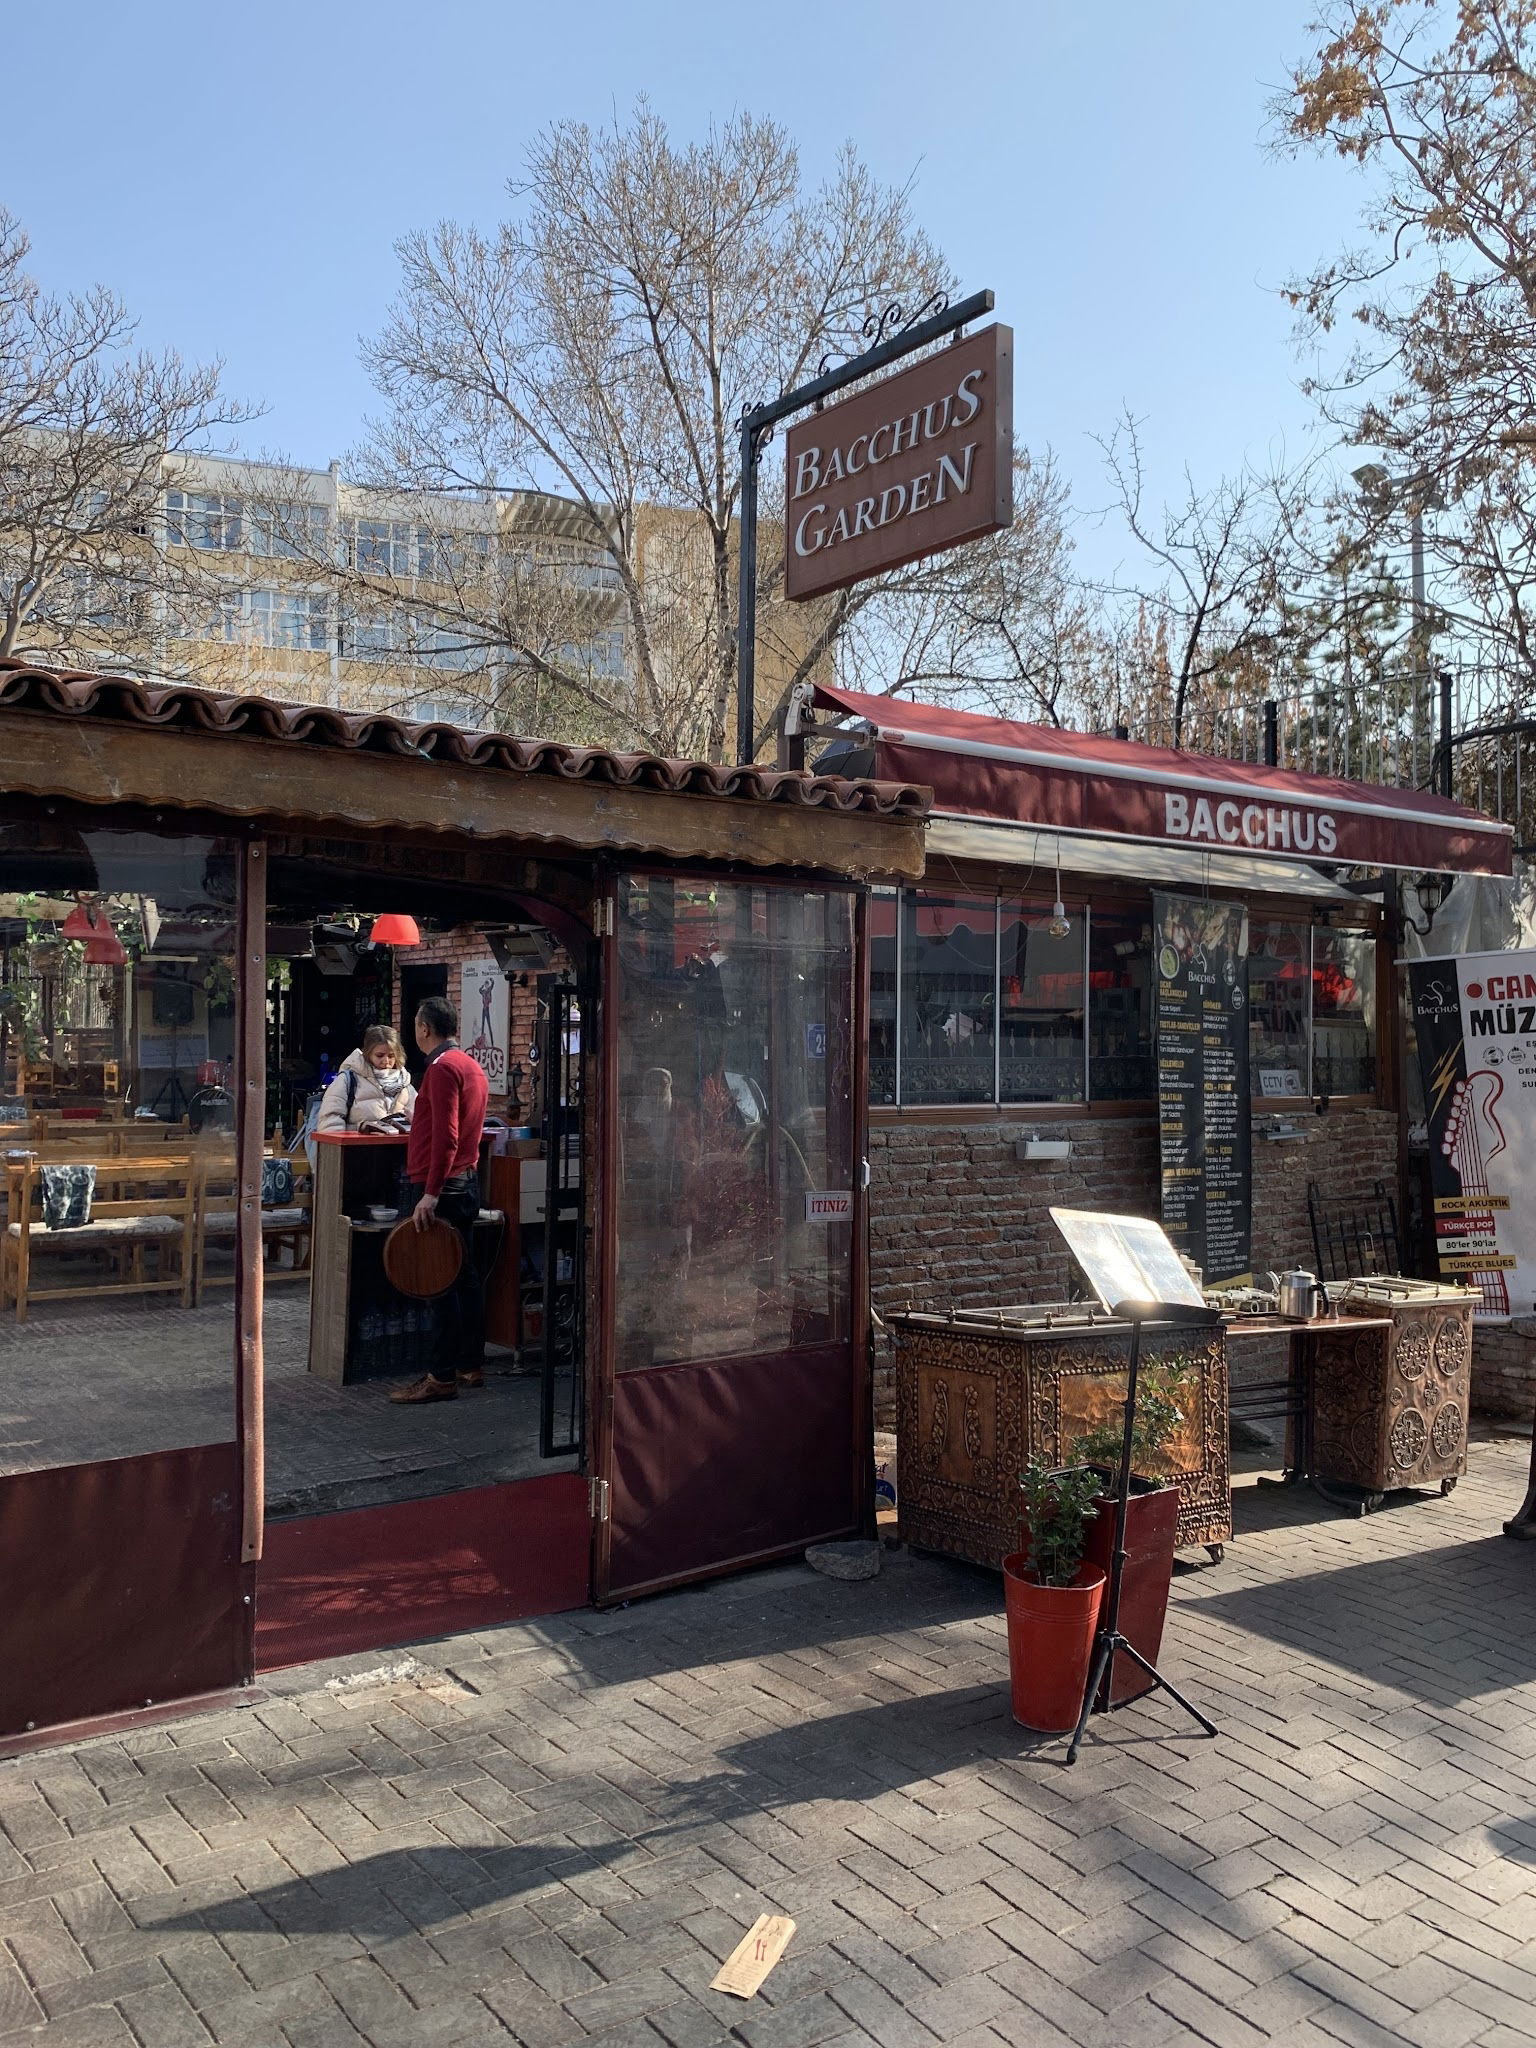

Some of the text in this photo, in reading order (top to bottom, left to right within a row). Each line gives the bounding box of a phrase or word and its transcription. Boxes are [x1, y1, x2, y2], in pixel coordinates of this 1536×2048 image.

[791, 369, 984, 500] BACCHUS
[794, 442, 977, 556] GARDEN
[1165, 793, 1337, 853] BACCHUS
[1188, 971, 1216, 984] BACCHUS
[1417, 1003, 1459, 1015] BACCHUS
[1470, 1003, 1536, 1037] MÜZ
[1263, 1076, 1282, 1088] CCTV
[1441, 1198, 1508, 1209] ROCK AKUSTİK
[1443, 1221, 1475, 1230] TÜRKÇE
[1446, 1240, 1497, 1249] 80'ler 90'lar
[1448, 1259, 1514, 1269] TÜRKÇE BLUES
